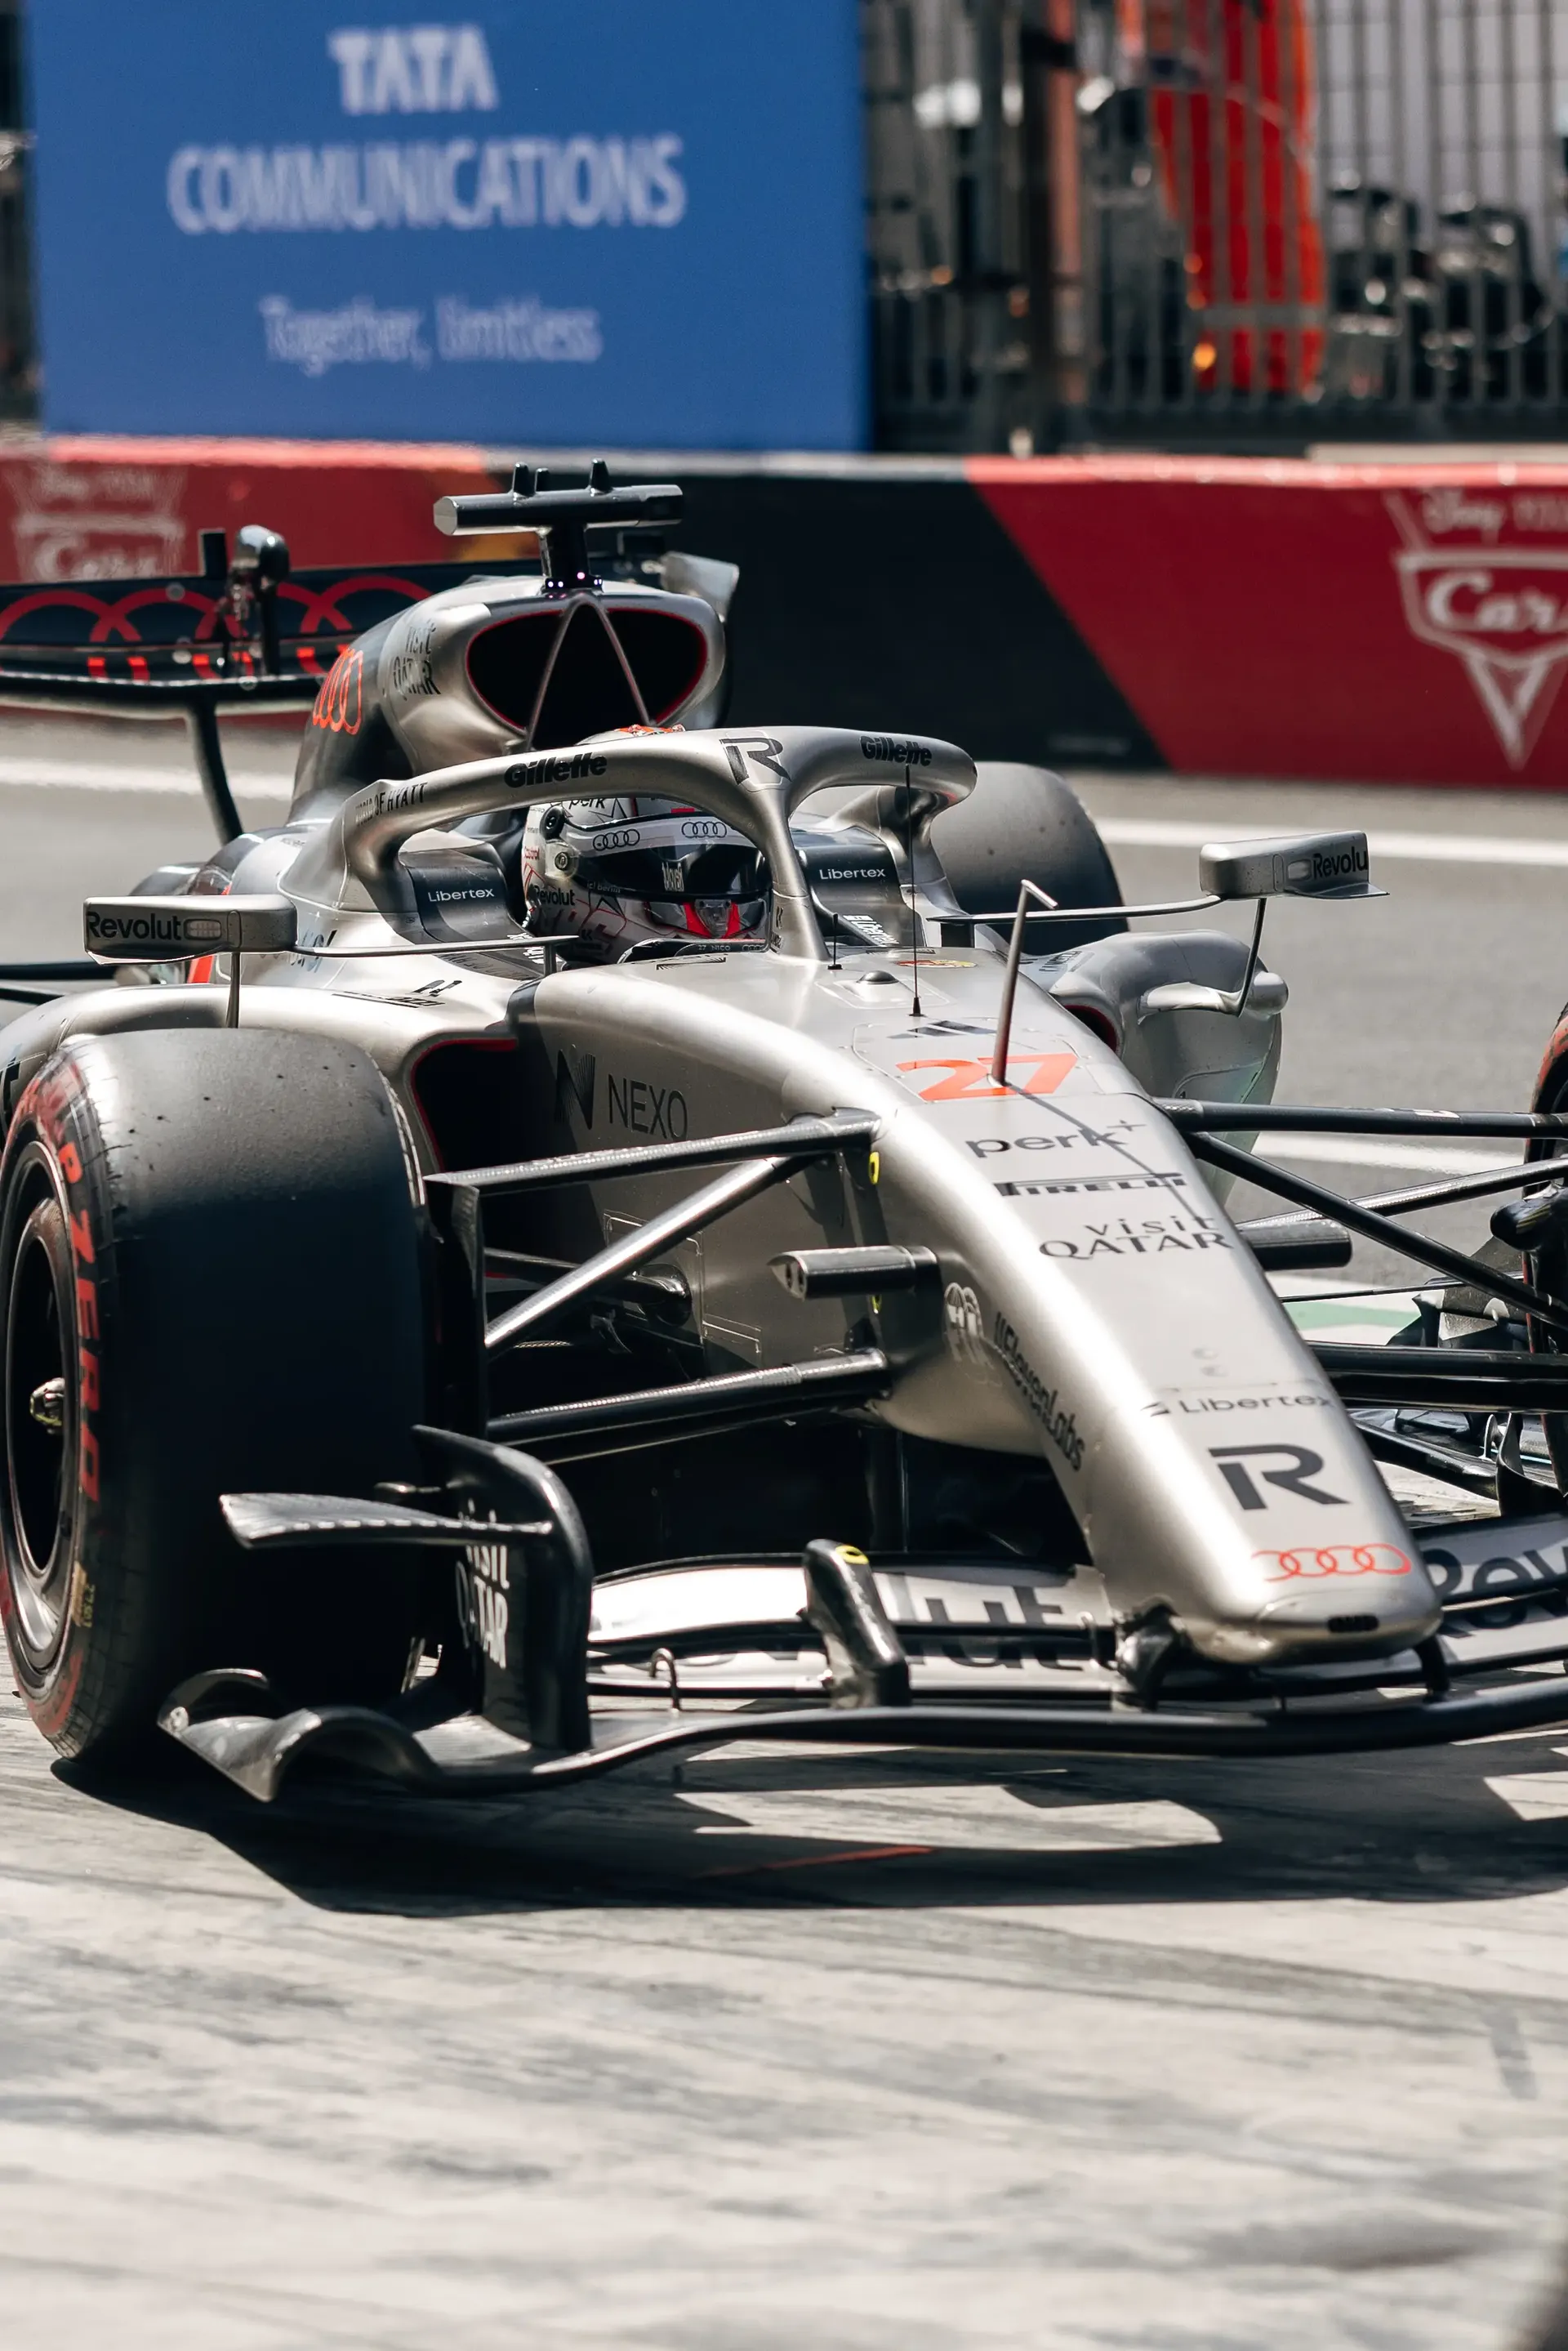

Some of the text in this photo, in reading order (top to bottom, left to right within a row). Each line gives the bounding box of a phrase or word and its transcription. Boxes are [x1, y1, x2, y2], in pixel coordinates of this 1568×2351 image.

[328, 23, 500, 115] TATA
[167, 132, 688, 234] COMMUNICATIONS
[1425, 570, 1568, 634] Car
[719, 738, 791, 786] R
[859, 735, 933, 766] Gillette
[503, 752, 608, 788] Gillette
[819, 868, 887, 880] Libertex
[427, 886, 495, 903] Libertex
[529, 883, 576, 907] Revolut
[86, 911, 182, 941] Revolut
[894, 1051, 1080, 1101] 27
[608, 1073, 688, 1143] NEXO
[991, 1172, 1189, 1197] PIRELLI
[1085, 1216, 1218, 1237] visit
[1039, 1232, 1236, 1260] QATAR
[59, 1141, 100, 1502] P ZERO
[1178, 1394, 1338, 1414] Libertex
[1208, 1442, 1352, 1511] R
